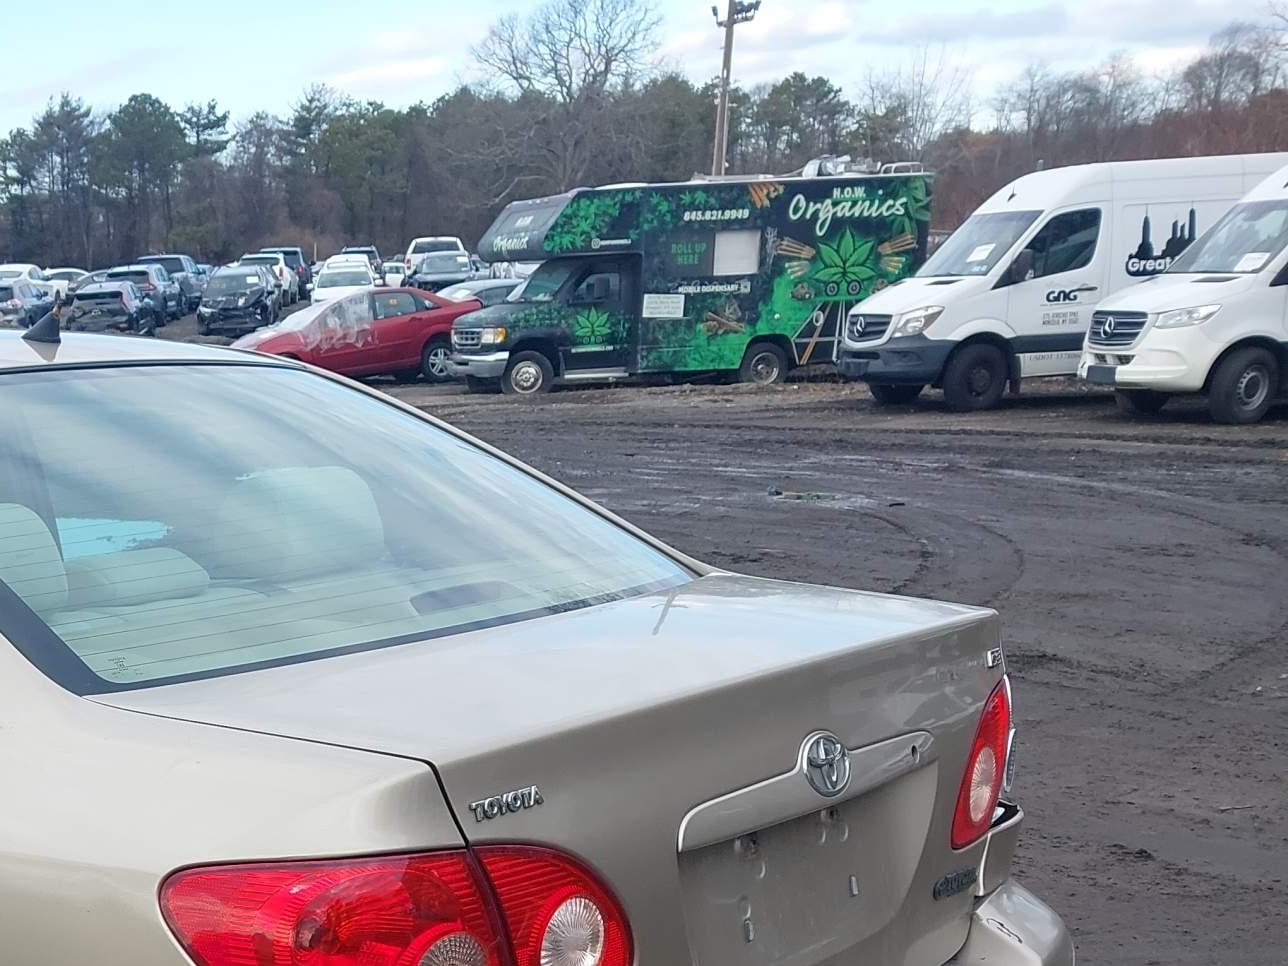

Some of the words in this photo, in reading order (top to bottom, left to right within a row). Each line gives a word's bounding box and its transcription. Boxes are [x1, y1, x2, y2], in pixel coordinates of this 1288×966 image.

[832, 186, 867, 199] H.O.W.
[789, 189, 908, 236] Organics
[1127, 257, 1171, 273] Great
[469, 785, 544, 822] TOYOTA
